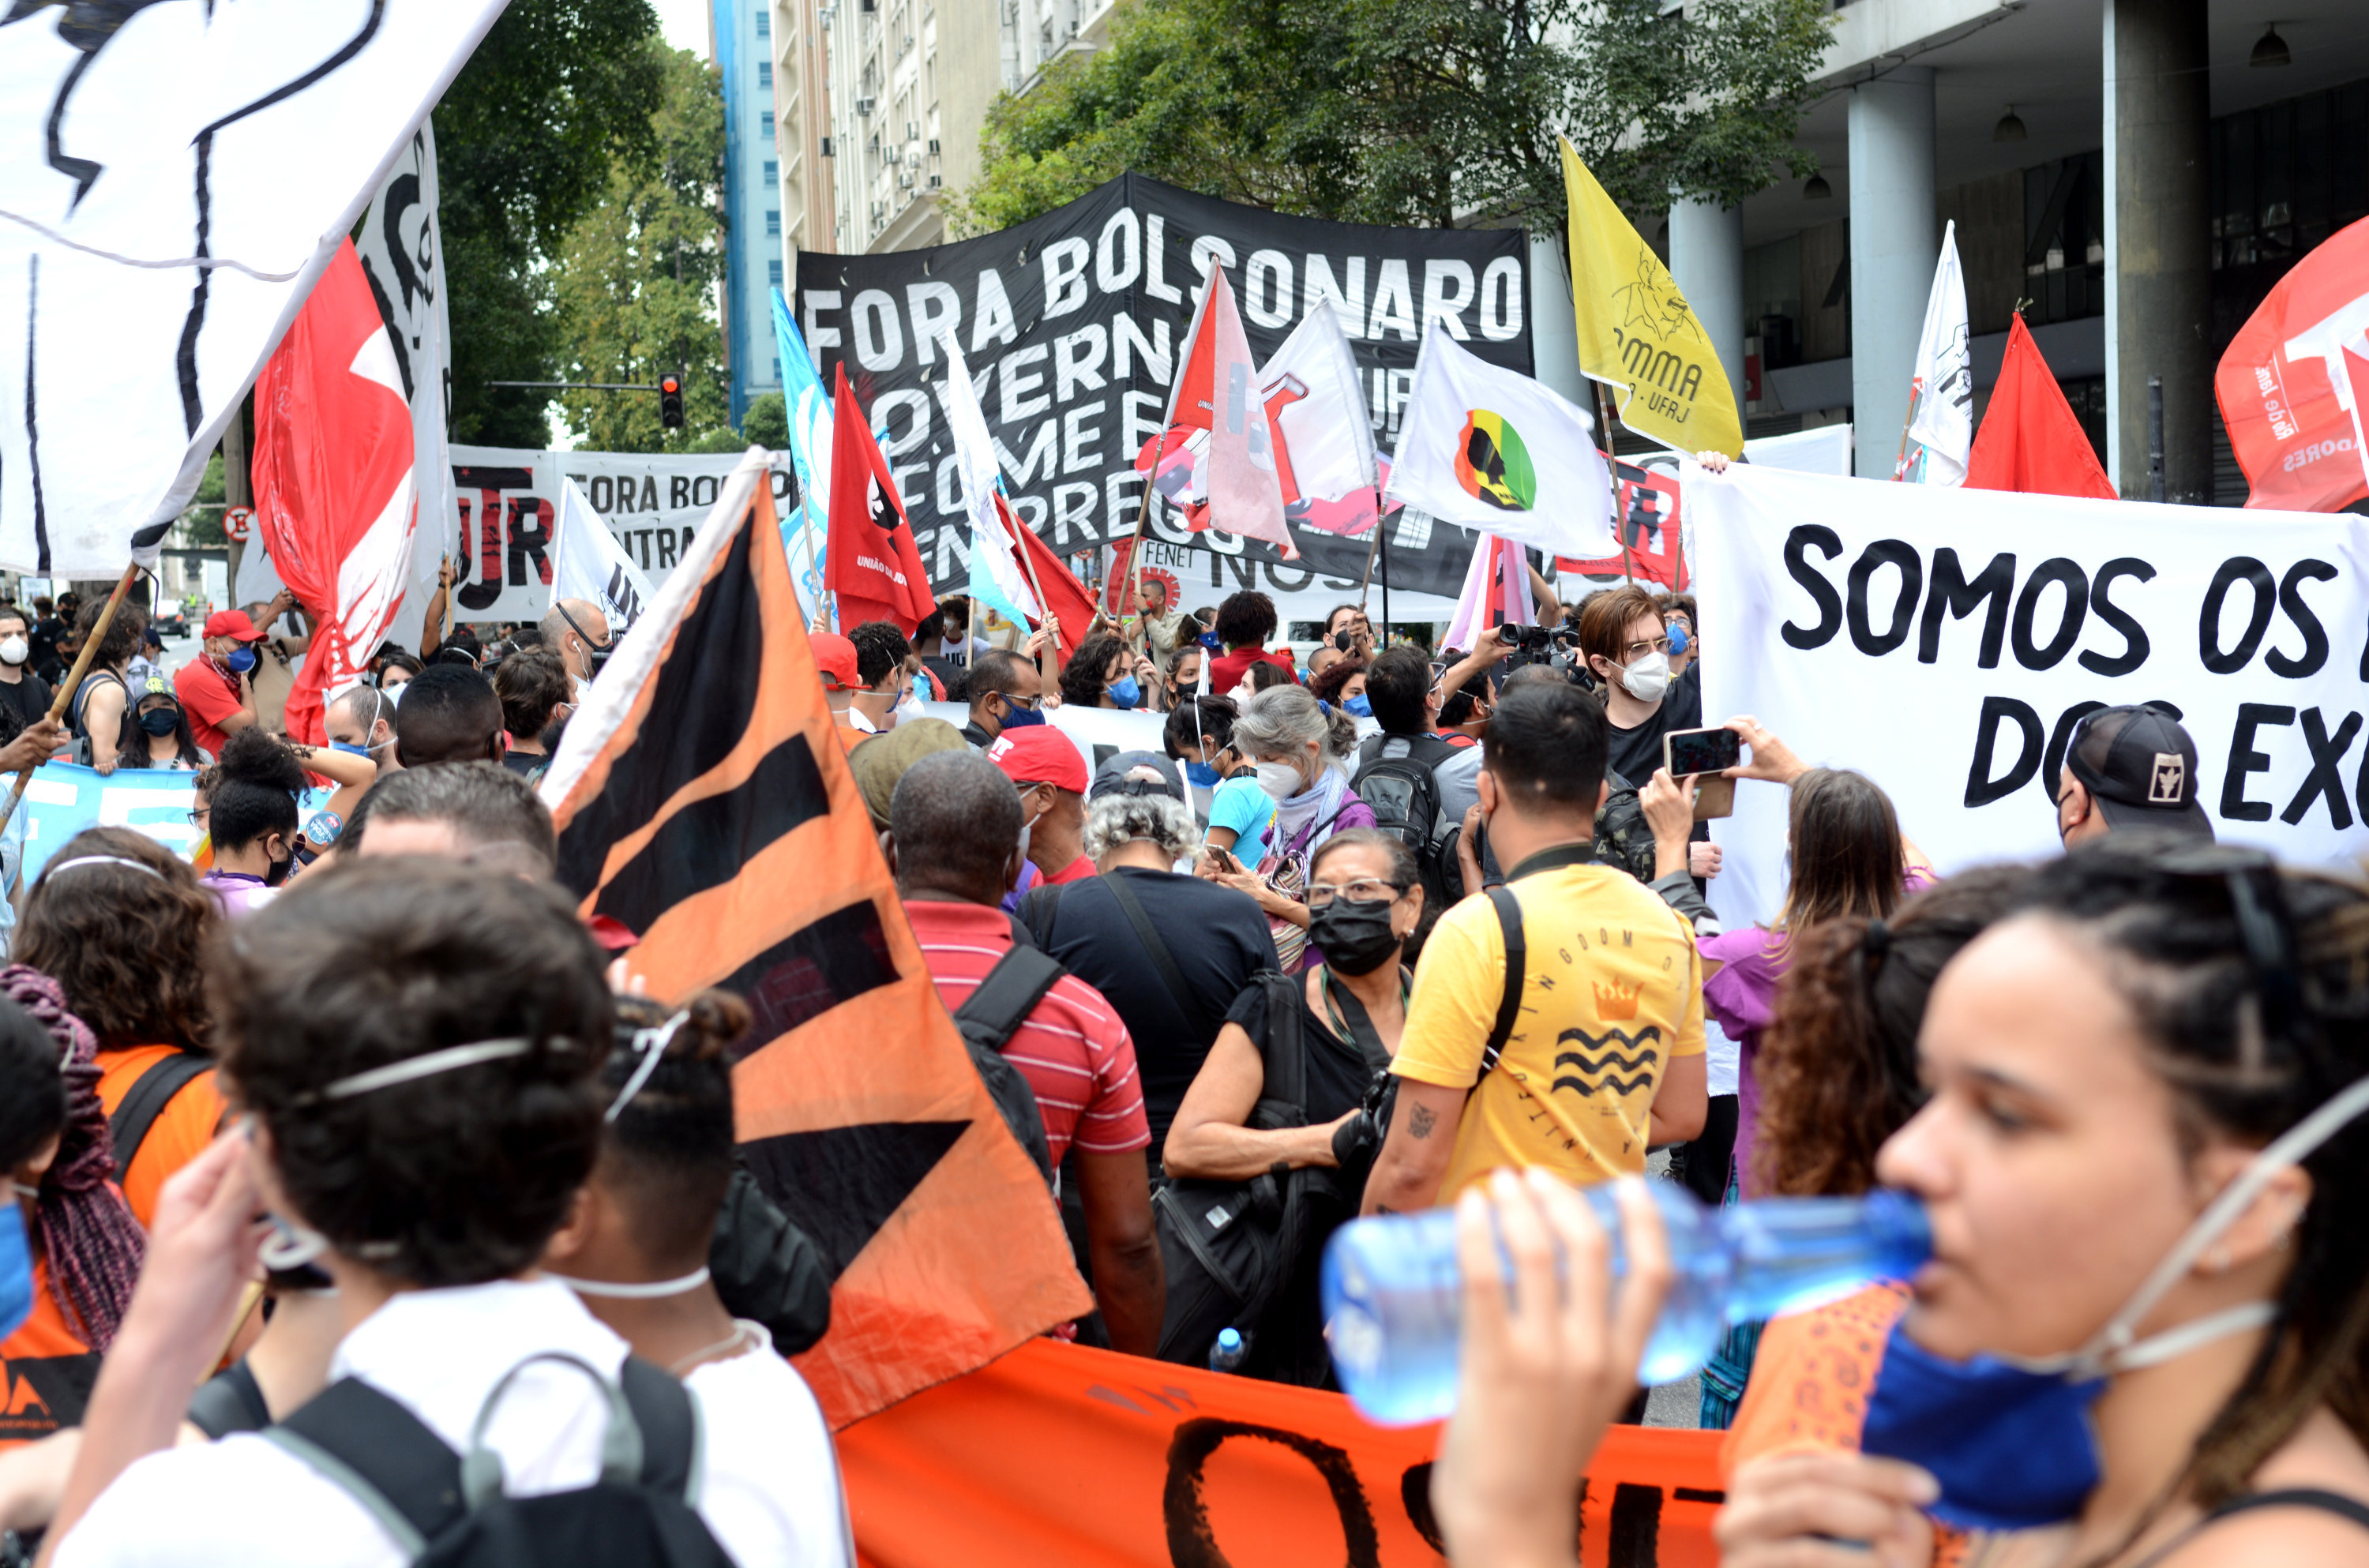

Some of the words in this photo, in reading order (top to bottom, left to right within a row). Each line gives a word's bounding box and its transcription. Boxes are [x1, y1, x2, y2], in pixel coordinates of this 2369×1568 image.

[804, 268, 1018, 375] FORA
[1042, 207, 1522, 342] BOLSONARO
[829, 313, 1186, 456] OVERN
[1648, 392, 1690, 423] UFRJ
[857, 555, 884, 573] UNIÃO
[893, 571, 907, 587] JUV
[1145, 542, 1192, 568] FENET
[1781, 523, 2157, 677] SOMOS
[2199, 556, 2339, 679] OS
[1964, 696, 2184, 808] DO
[2220, 703, 2369, 831] EX
